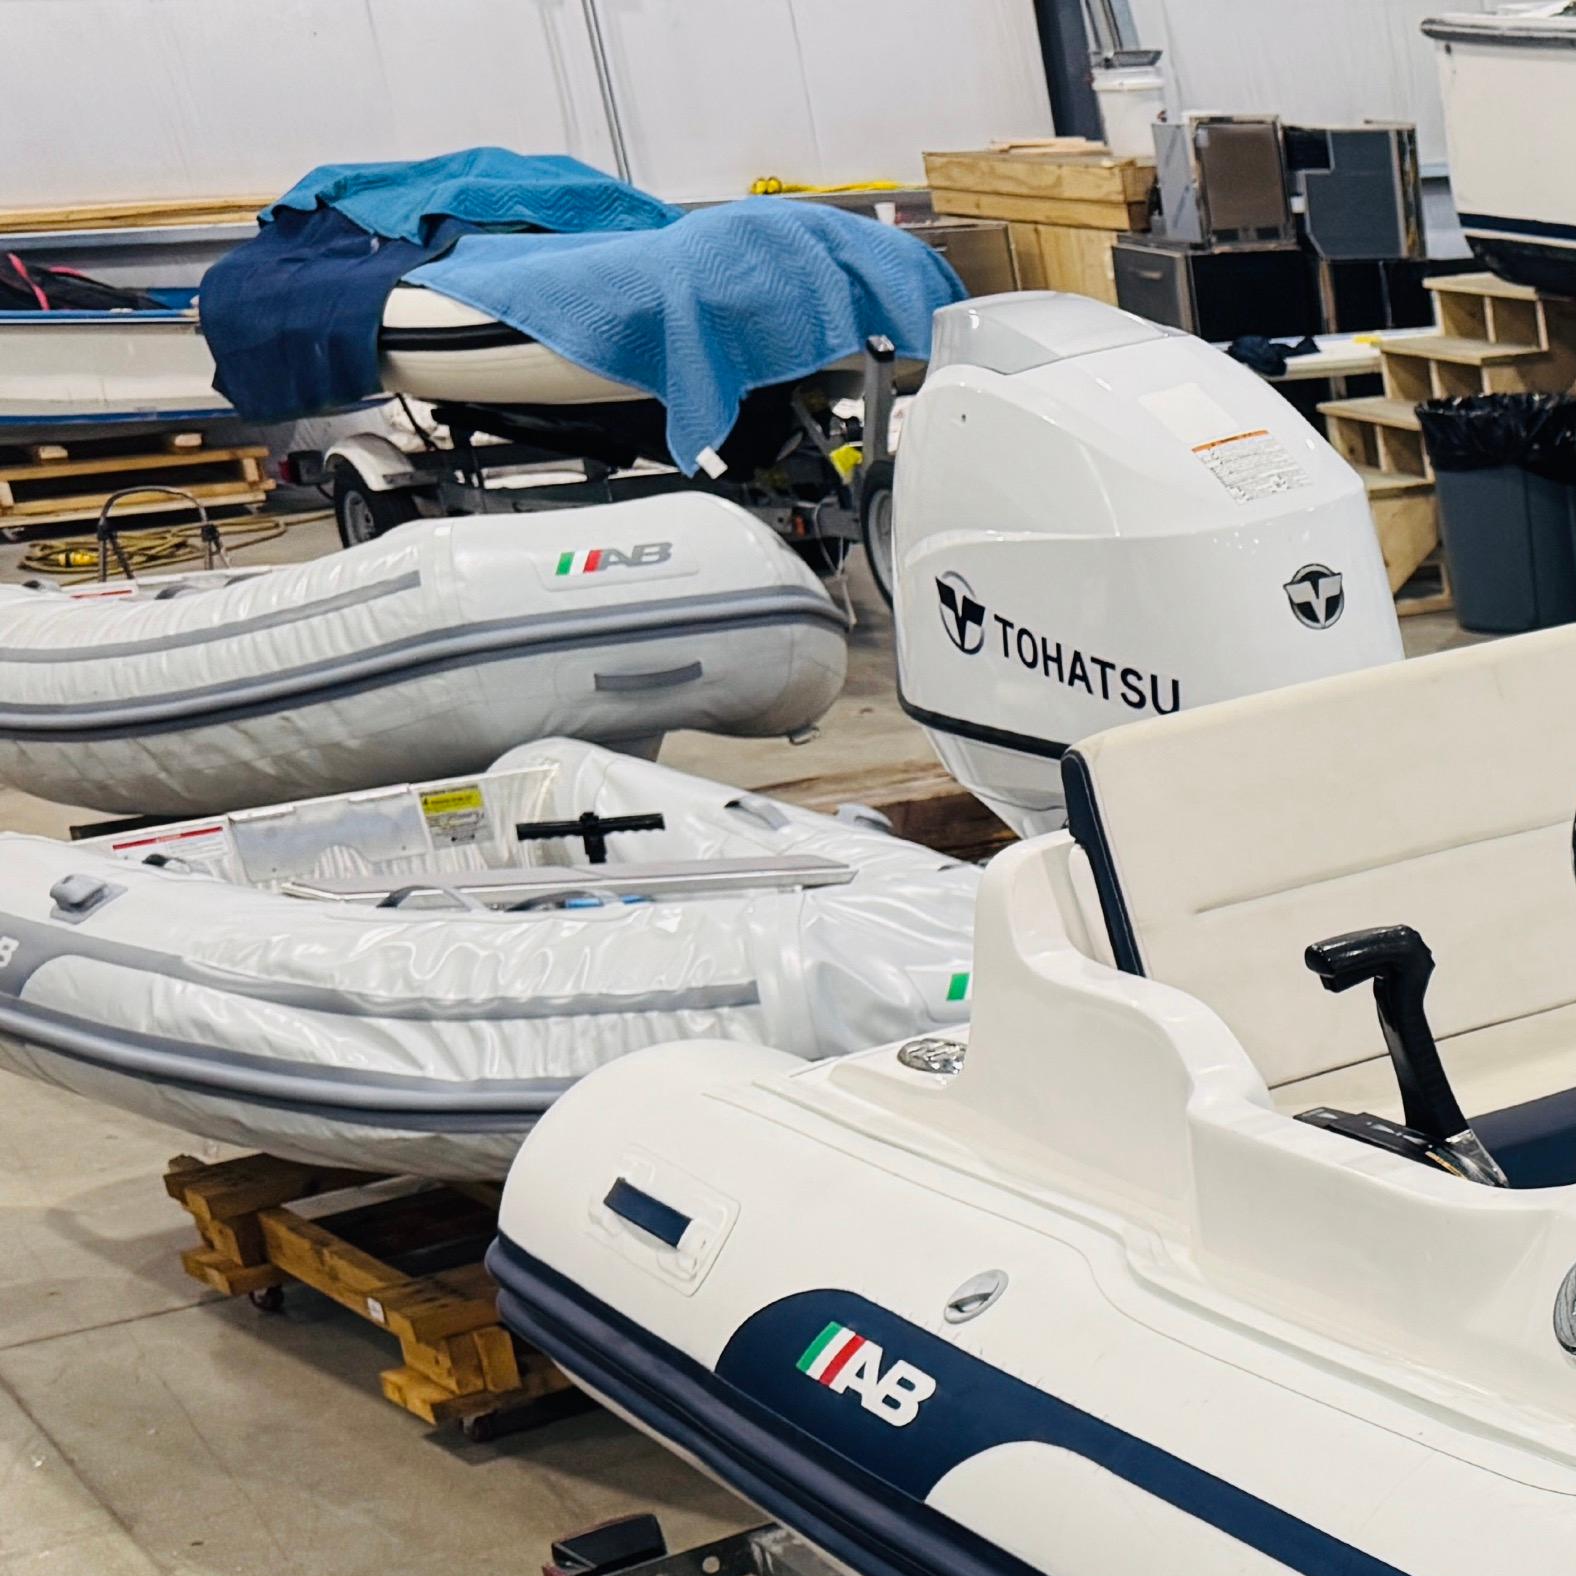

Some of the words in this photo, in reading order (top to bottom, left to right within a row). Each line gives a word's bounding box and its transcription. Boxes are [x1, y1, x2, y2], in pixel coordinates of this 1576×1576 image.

[598, 541, 673, 572] AB
[994, 614, 1180, 716] TOHATSU
[828, 1340, 937, 1427] AB
